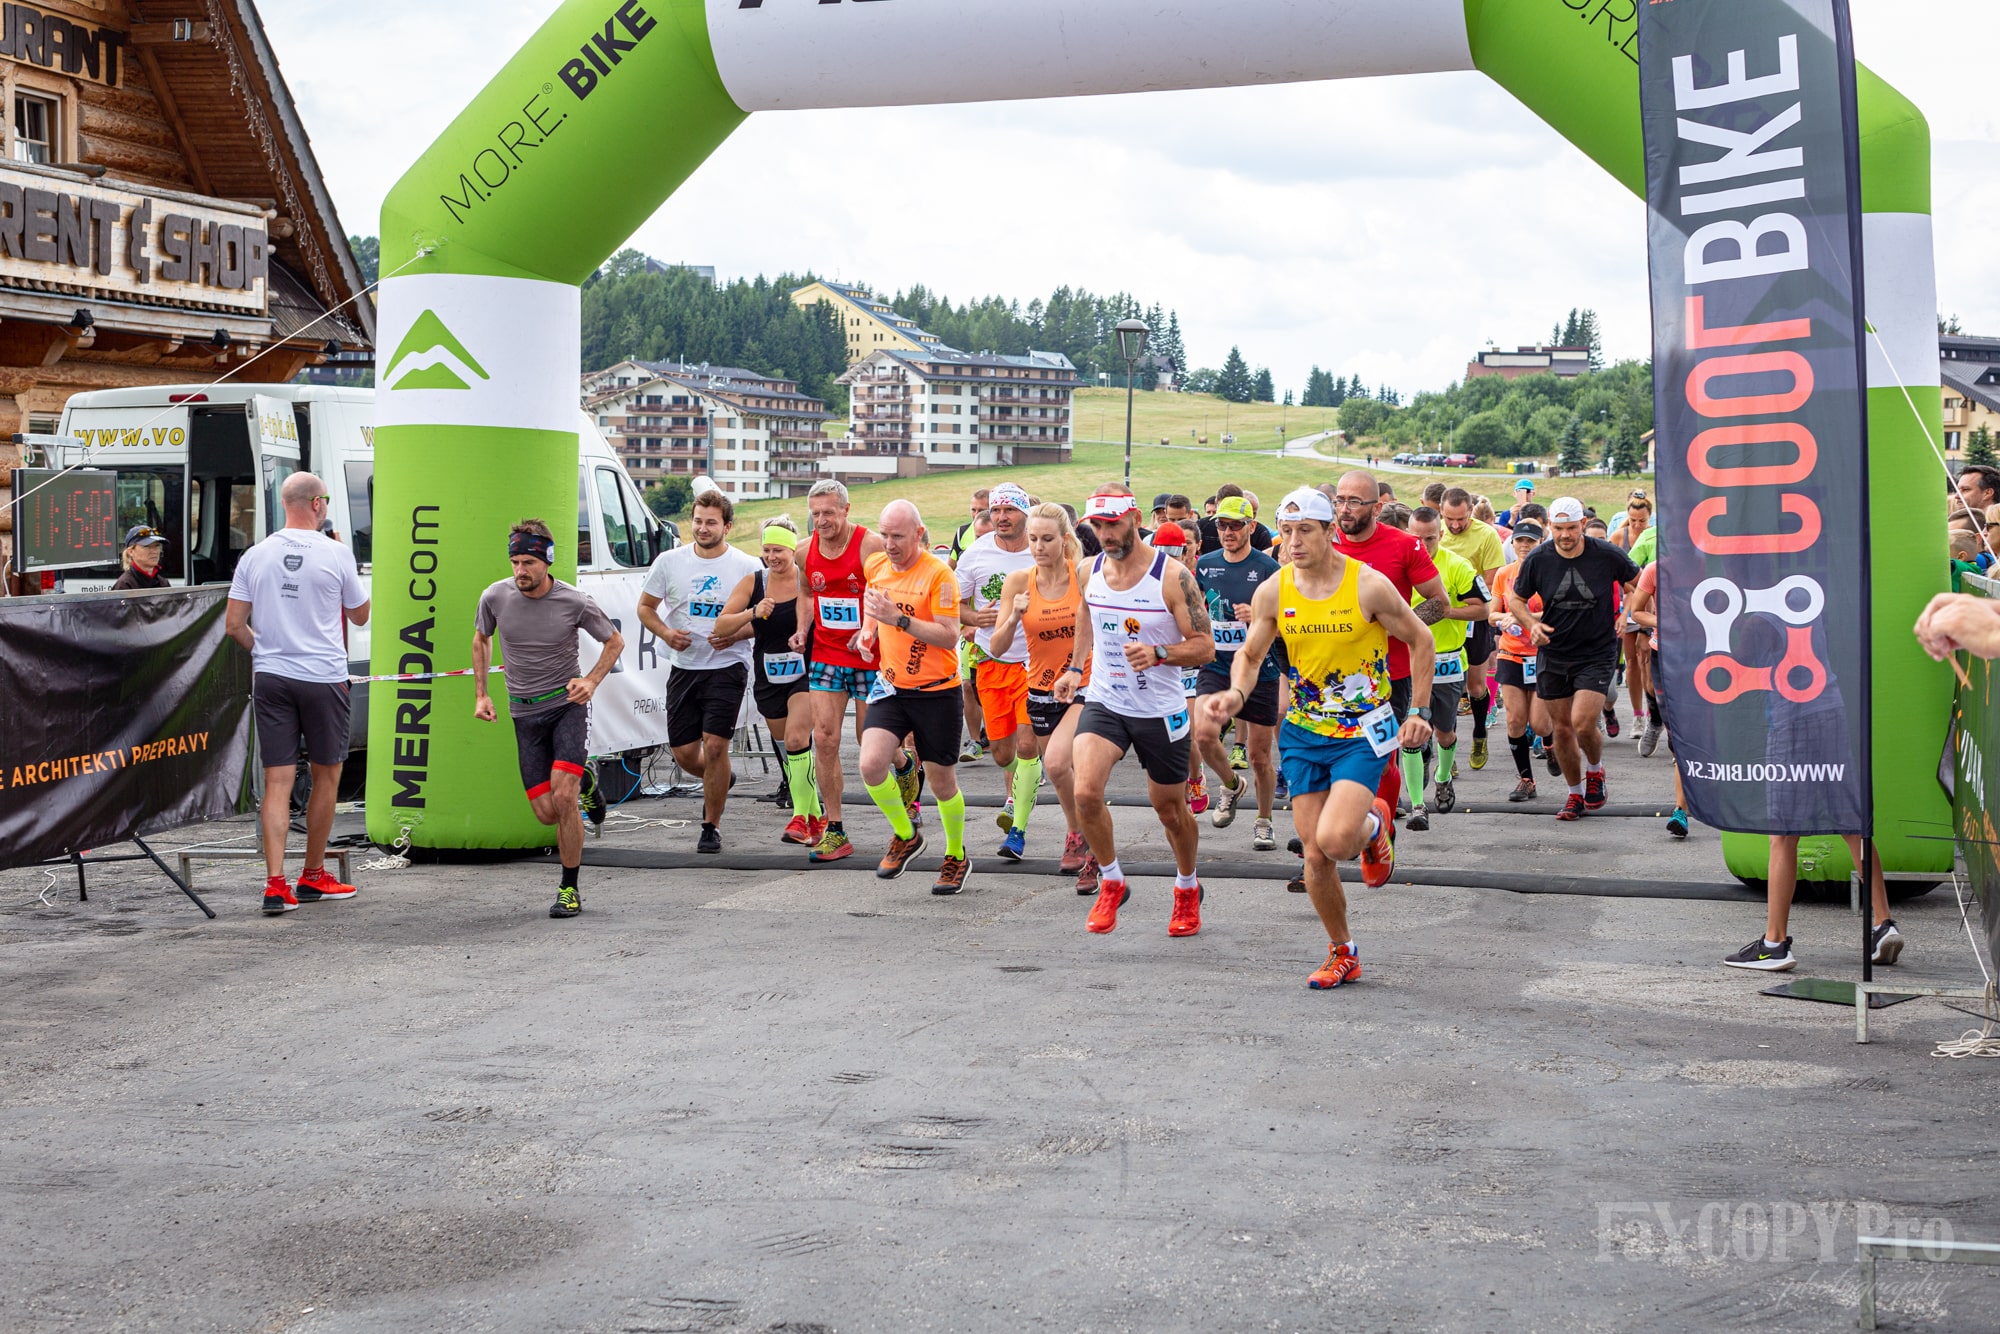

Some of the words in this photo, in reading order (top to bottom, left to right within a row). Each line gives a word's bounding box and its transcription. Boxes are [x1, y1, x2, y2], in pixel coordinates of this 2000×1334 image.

[557, 0, 658, 100] BIKE
[0, 181, 120, 277] RENT
[161, 213, 268, 291] SHOP
[35, 490, 113, 548] 11:15:02
[693, 602, 725, 617] 578
[823, 605, 852, 621] 551
[1214, 629, 1244, 643] 504
[1285, 623, 1297, 634] ŠK
[1300, 623, 1353, 633] ACHILLES
[391, 505, 440, 809] MERIDA.com
[769, 660, 798, 675] 577
[1434, 661, 1458, 676] 02
[11, 749, 126, 788] ARCHITEKTI
[131, 731, 209, 766] PREPRAVY
